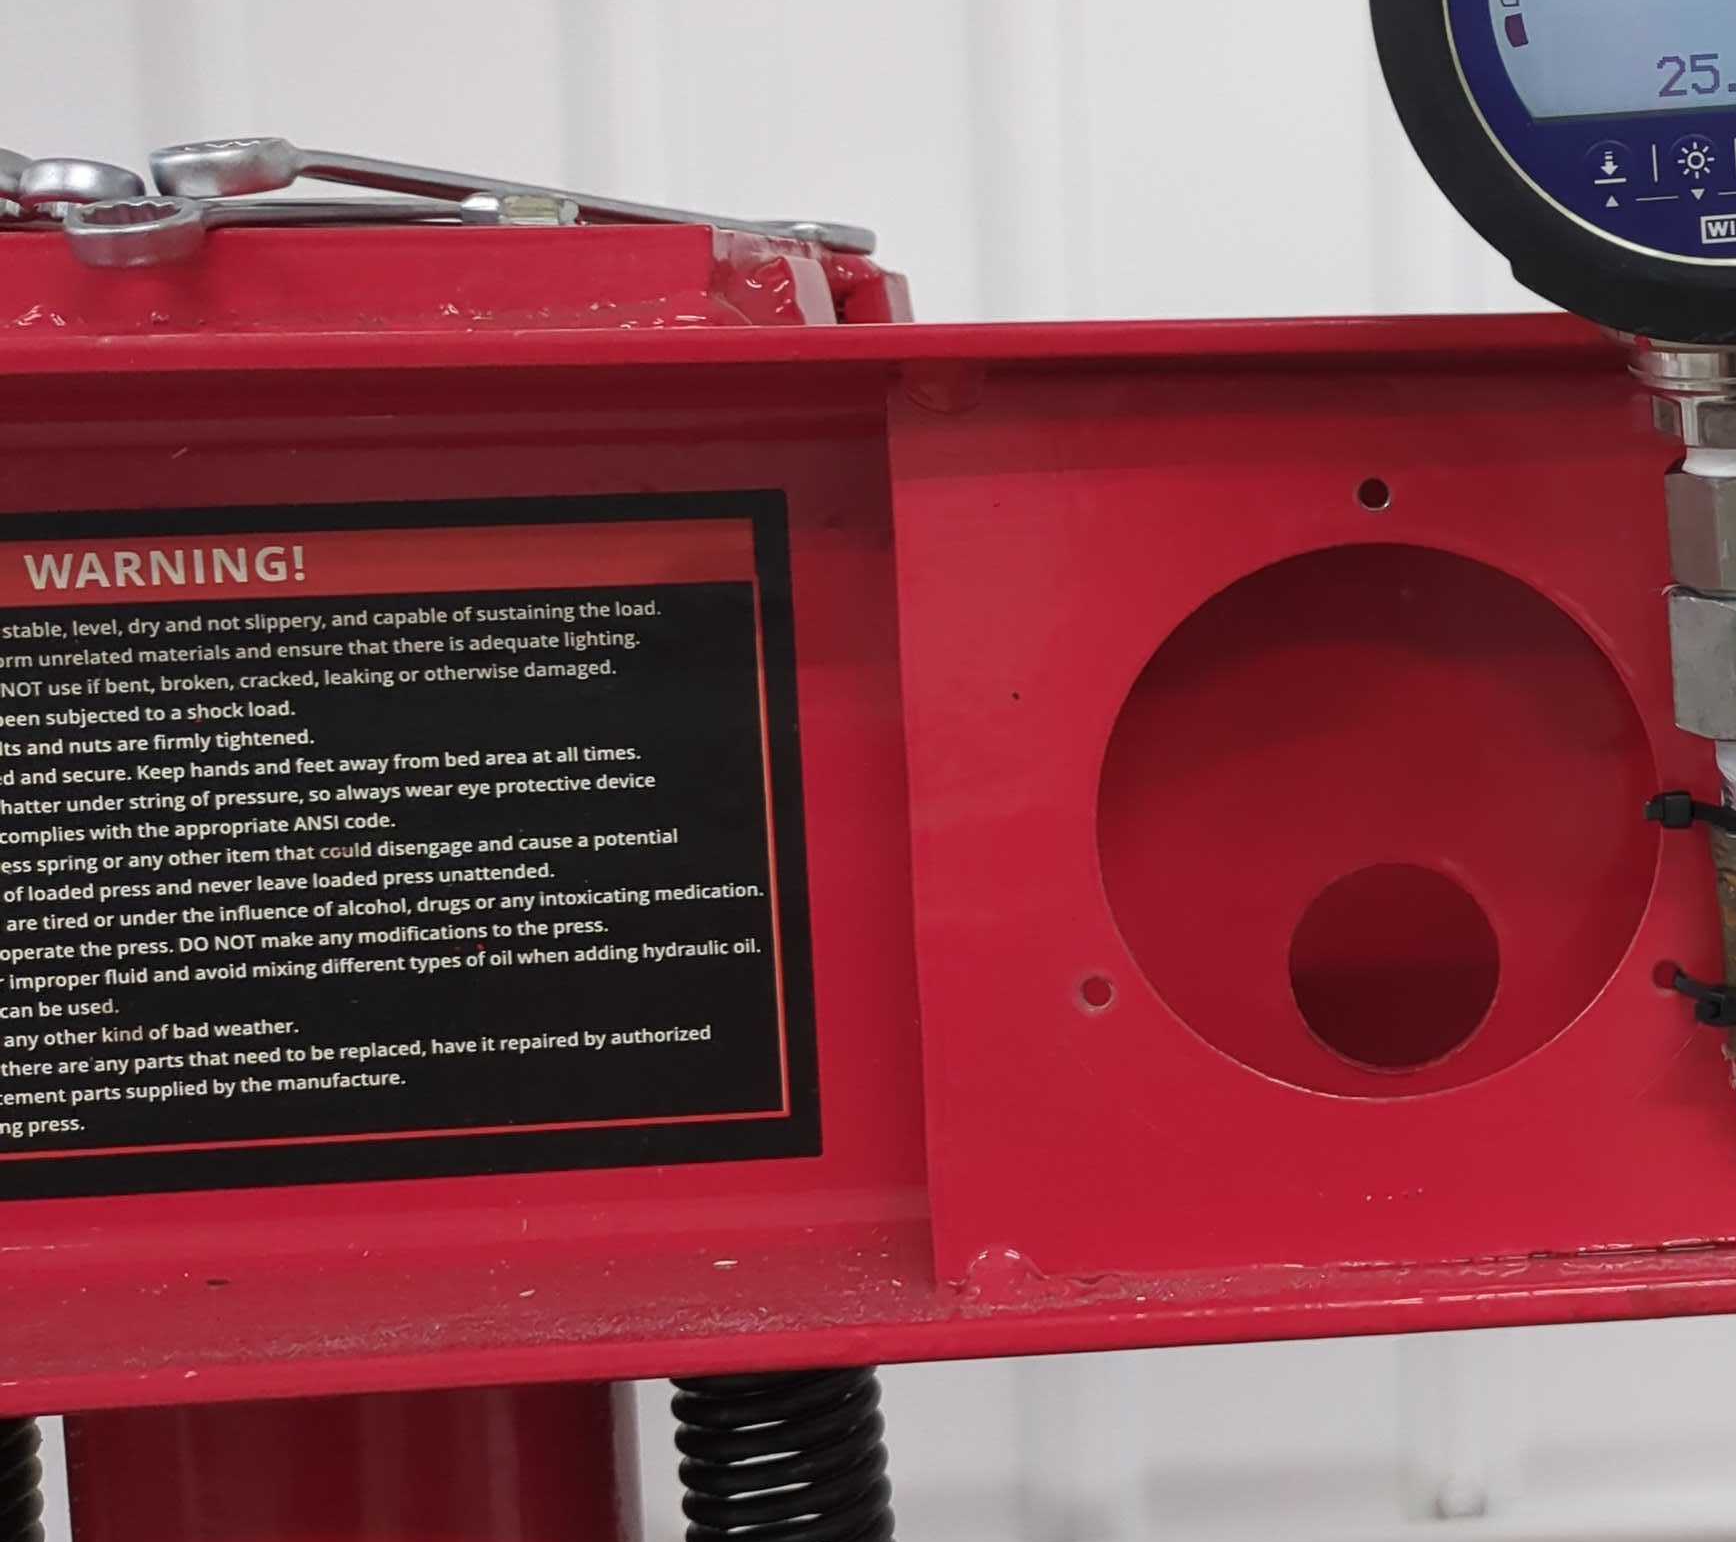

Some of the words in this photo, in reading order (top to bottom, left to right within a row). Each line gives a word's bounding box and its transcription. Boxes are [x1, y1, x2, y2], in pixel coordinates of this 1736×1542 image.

[24, 546, 306, 590] WARNING!
[1, 620, 68, 640] stable,
[71, 617, 123, 637] level,
[127, 617, 161, 639] dry
[164, 614, 203, 634] and
[243, 612, 327, 634] slippery,
[330, 608, 369, 628] and
[372, 606, 448, 630] capable
[475, 602, 576, 623] sustaining
[614, 599, 662, 617] load.
[37, 646, 134, 668] unrelated
[137, 643, 231, 664] materials
[275, 642, 344, 659] ensure
[347, 638, 389, 656] that
[391, 636, 445, 655] there
[468, 633, 560, 654] adequate
[563, 629, 641, 652] lighting.
[0, 680, 43, 699] NOT
[104, 676, 156, 695] bent,
[159, 673, 235, 692] broken,
[238, 669, 320, 689] cracked,
[323, 667, 395, 688] leaking
[423, 662, 520, 682] otherwise
[522, 657, 617, 681] damaged.
[44, 704, 141, 729] subjected
[185, 700, 245, 721] shock
[247, 698, 297, 718] load.
[25, 737, 64, 756] and
[67, 738, 113, 755] nuts
[151, 731, 212, 754] firmly
[214, 727, 315, 752] tightened.
[19, 766, 58, 786] and
[61, 767, 133, 784] secure.
[135, 763, 186, 784] Keep
[189, 758, 251, 779] hands
[253, 756, 292, 776] and
[294, 756, 336, 774] feet
[337, 757, 390, 775] away
[391, 752, 440, 770] from
[582, 744, 642, 763] times.
[65, 793, 125, 813] under
[127, 791, 187, 813] string
[213, 789, 305, 811] pressure,
[334, 783, 402, 804] always
[403, 783, 454, 798] wear
[494, 774, 592, 799] protective
[594, 771, 657, 791] device
[0, 825, 86, 848] complies
[87, 822, 133, 841] with
[173, 816, 290, 842] appropriate
[292, 813, 340, 833] ANSI
[343, 811, 397, 830] code.
[35, 853, 99, 877] spring
[126, 853, 164, 872] any
[167, 848, 223, 867] other
[225, 846, 271, 864] item
[273, 844, 316, 862] that
[318, 840, 373, 860] could
[375, 839, 474, 860] disengage
[476, 834, 514, 853] and
[517, 835, 574, 851] cause
[592, 826, 679, 852] potential
[27, 881, 95, 902] loaded
[98, 883, 152, 904] press
[154, 877, 193, 897] and
[196, 878, 253, 895] never
[255, 874, 309, 892] leave
[311, 868, 379, 889] loaded
[381, 870, 435, 891] press
[437, 861, 556, 884] unattended.
[41, 911, 89, 931] tired
[118, 908, 179, 928] under
[218, 903, 309, 923] influence
[337, 895, 413, 917] alcohol,
[415, 895, 472, 916] drugs
[538, 886, 651, 908] intoxicating
[653, 881, 765, 902] medication.
[0, 943, 76, 966] operate
[115, 940, 175, 961] press.
[213, 932, 257, 952] NOT
[260, 930, 315, 950] make
[356, 923, 489, 945] modifications
[551, 919, 609, 940] press.
[8, 972, 101, 994] improper
[102, 966, 149, 986] fluid
[152, 964, 190, 983] and
[193, 961, 248, 982] avoid
[251, 959, 319, 980] mixing
[320, 956, 407, 975] different
[408, 954, 462, 975] types
[515, 947, 570, 965] when
[573, 943, 640, 964] adding
[641, 938, 730, 963] hydraulic
[66, 997, 120, 1017] used.
[0, 1059, 54, 1078] there
[93, 1056, 130, 1076] any
[133, 1053, 185, 1075] parts
[187, 1049, 230, 1068] that
[232, 1045, 282, 1066] need
[338, 1038, 427, 1063] replaced,
[430, 1037, 478, 1055] have
[498, 1030, 580, 1055] repaired
[609, 1023, 712, 1046] authorized
[2, 1033, 40, 1052] any
[42, 1027, 98, 1047] other
[100, 1024, 144, 1044] kind
[171, 1020, 210, 1040] bad
[212, 1017, 300, 1038] weather.
[70, 1085, 122, 1107] parts
[124, 1078, 209, 1103] supplied
[276, 1071, 407, 1092] manufacture.
[27, 1117, 86, 1138] press.
